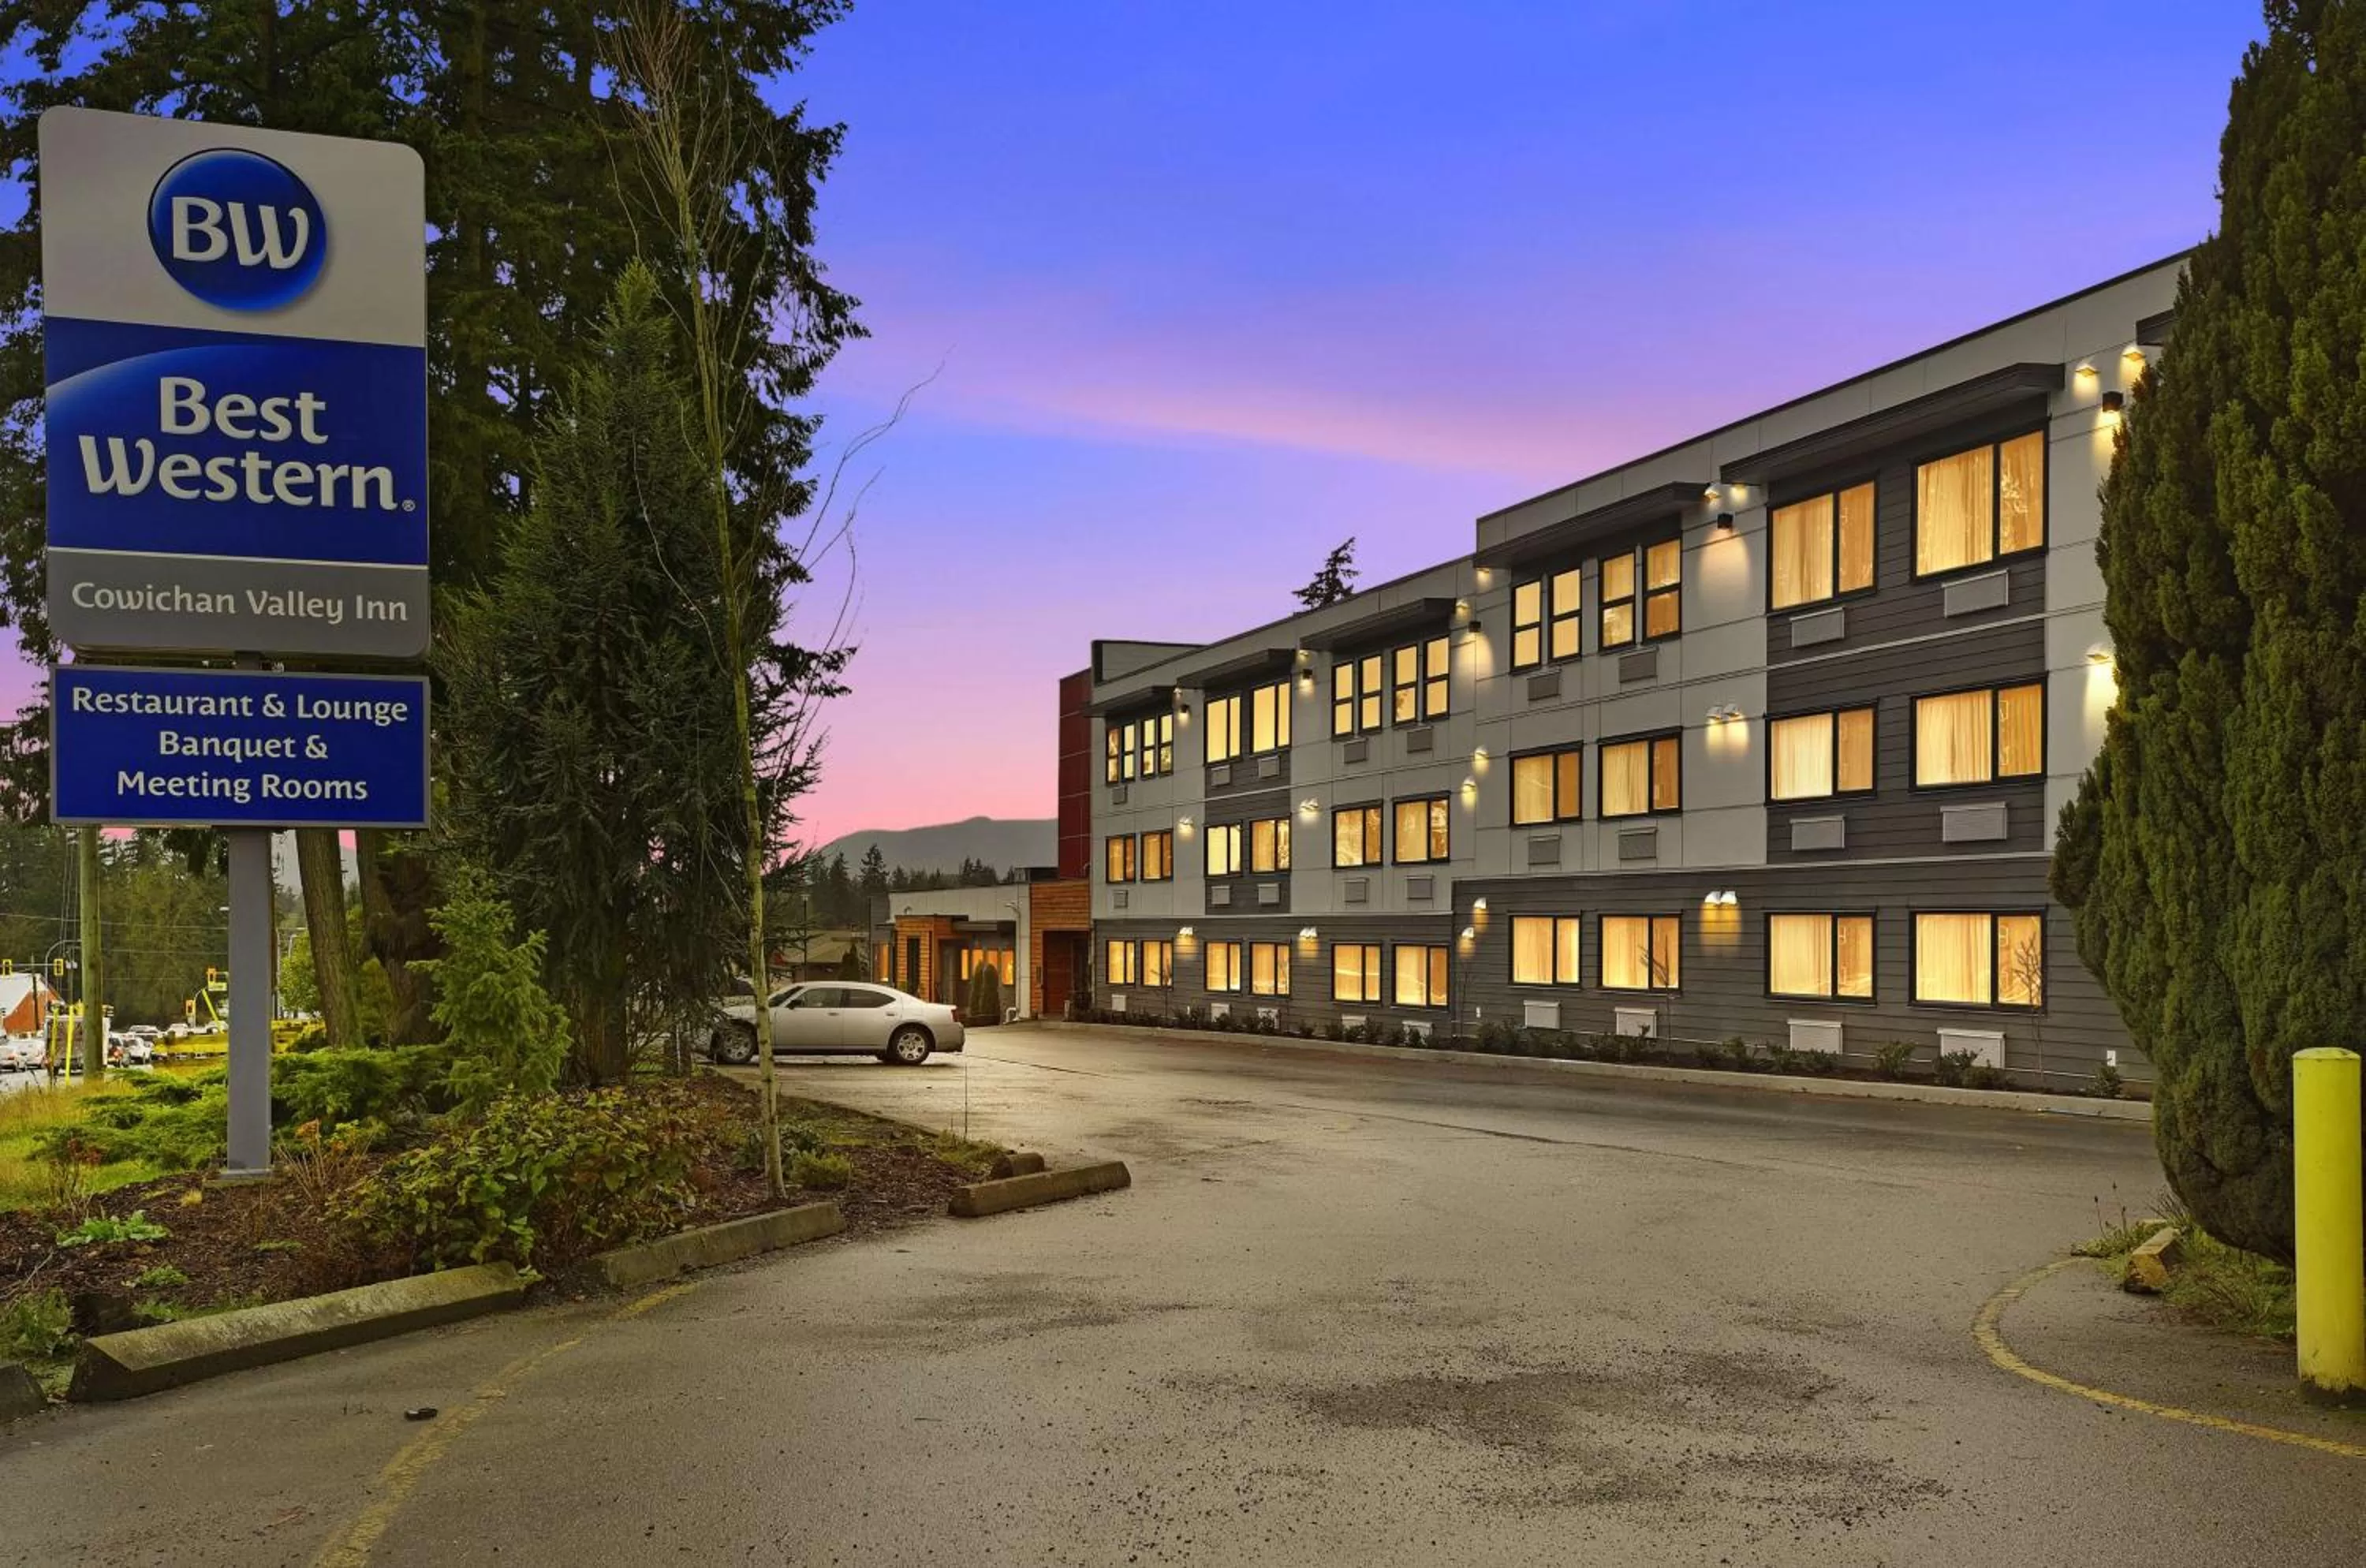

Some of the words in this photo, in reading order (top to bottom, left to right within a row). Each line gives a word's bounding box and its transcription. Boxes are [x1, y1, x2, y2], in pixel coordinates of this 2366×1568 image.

[170, 196, 309, 270] BW
[160, 376, 329, 444] Best
[72, 582, 236, 614] Cowichan
[246, 590, 343, 625] Valley
[356, 595, 407, 621] Inn
[73, 687, 253, 717] Restaurant
[263, 693, 285, 717] &
[297, 694, 408, 726] Lounge
[160, 731, 296, 763] Banquet
[305, 734, 328, 759] &
[118, 771, 251, 804] Meeting
[262, 774, 368, 800] Rooms
